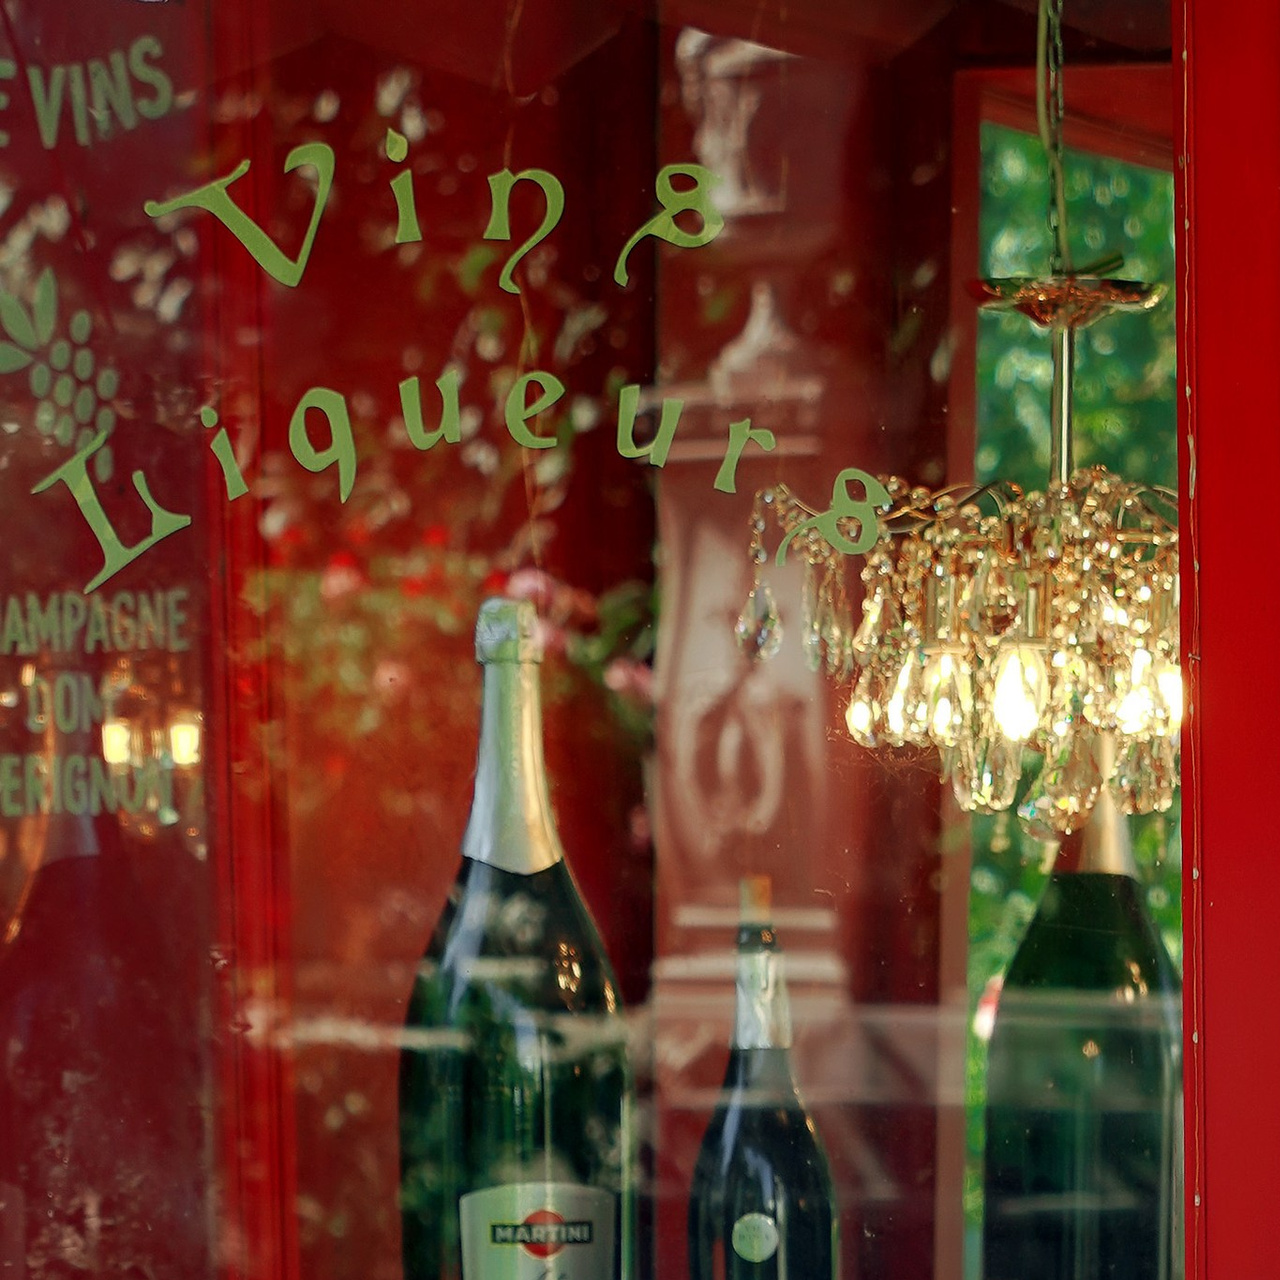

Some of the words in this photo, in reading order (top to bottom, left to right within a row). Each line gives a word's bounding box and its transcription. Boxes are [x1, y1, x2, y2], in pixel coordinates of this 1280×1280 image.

[27, 35, 173, 149] VINS
[144, 128, 724, 293] Vins
[31, 370, 893, 594] Liqueurs
[0, 590, 188, 654] AMPAGNE
[495, 1225, 590, 1242] MARTINI
